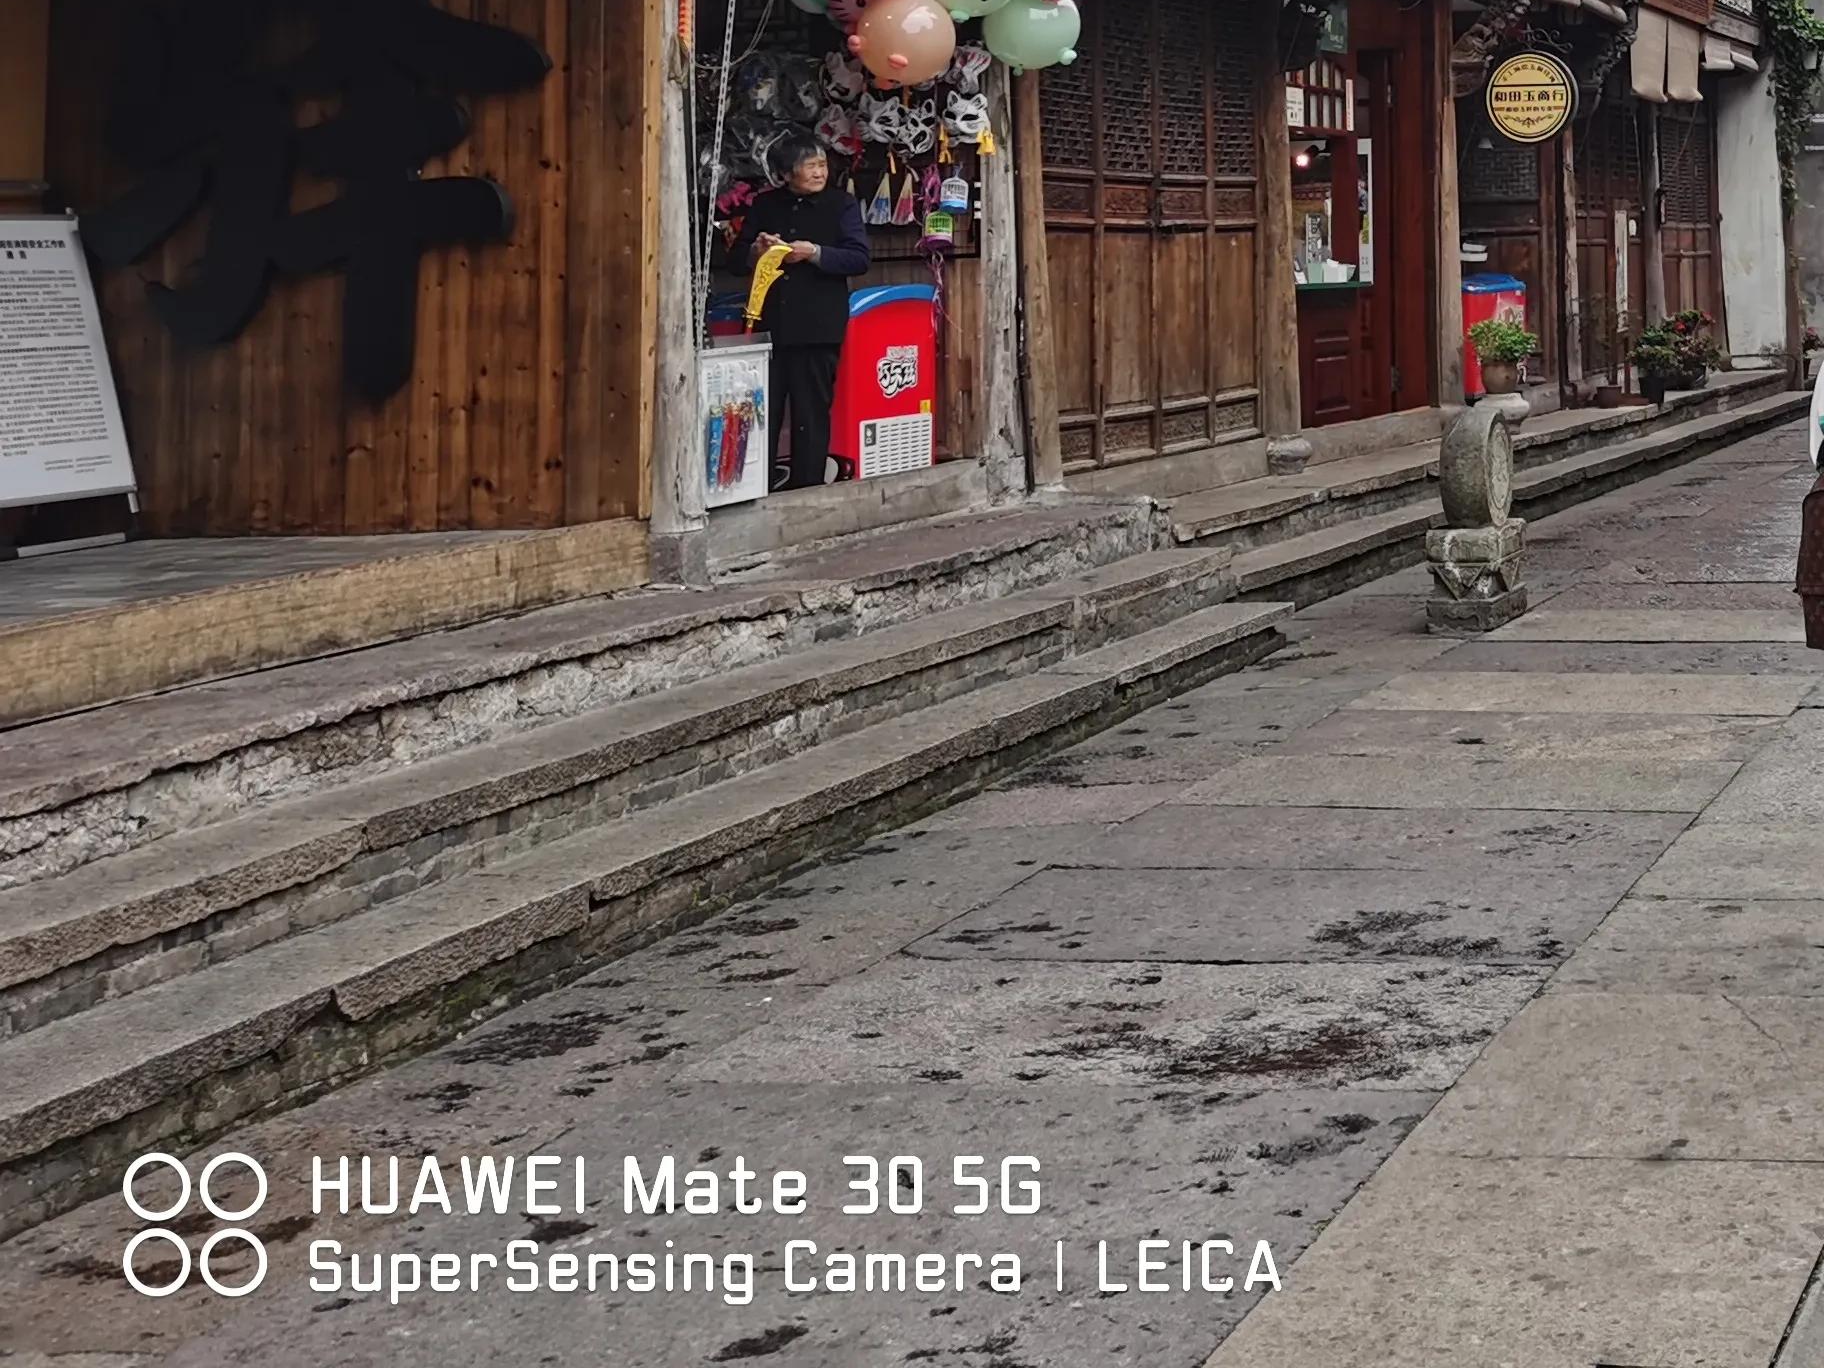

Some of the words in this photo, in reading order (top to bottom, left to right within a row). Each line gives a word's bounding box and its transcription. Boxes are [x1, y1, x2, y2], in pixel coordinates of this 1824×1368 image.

[1493, 89, 1564, 102] 和田玉商行
